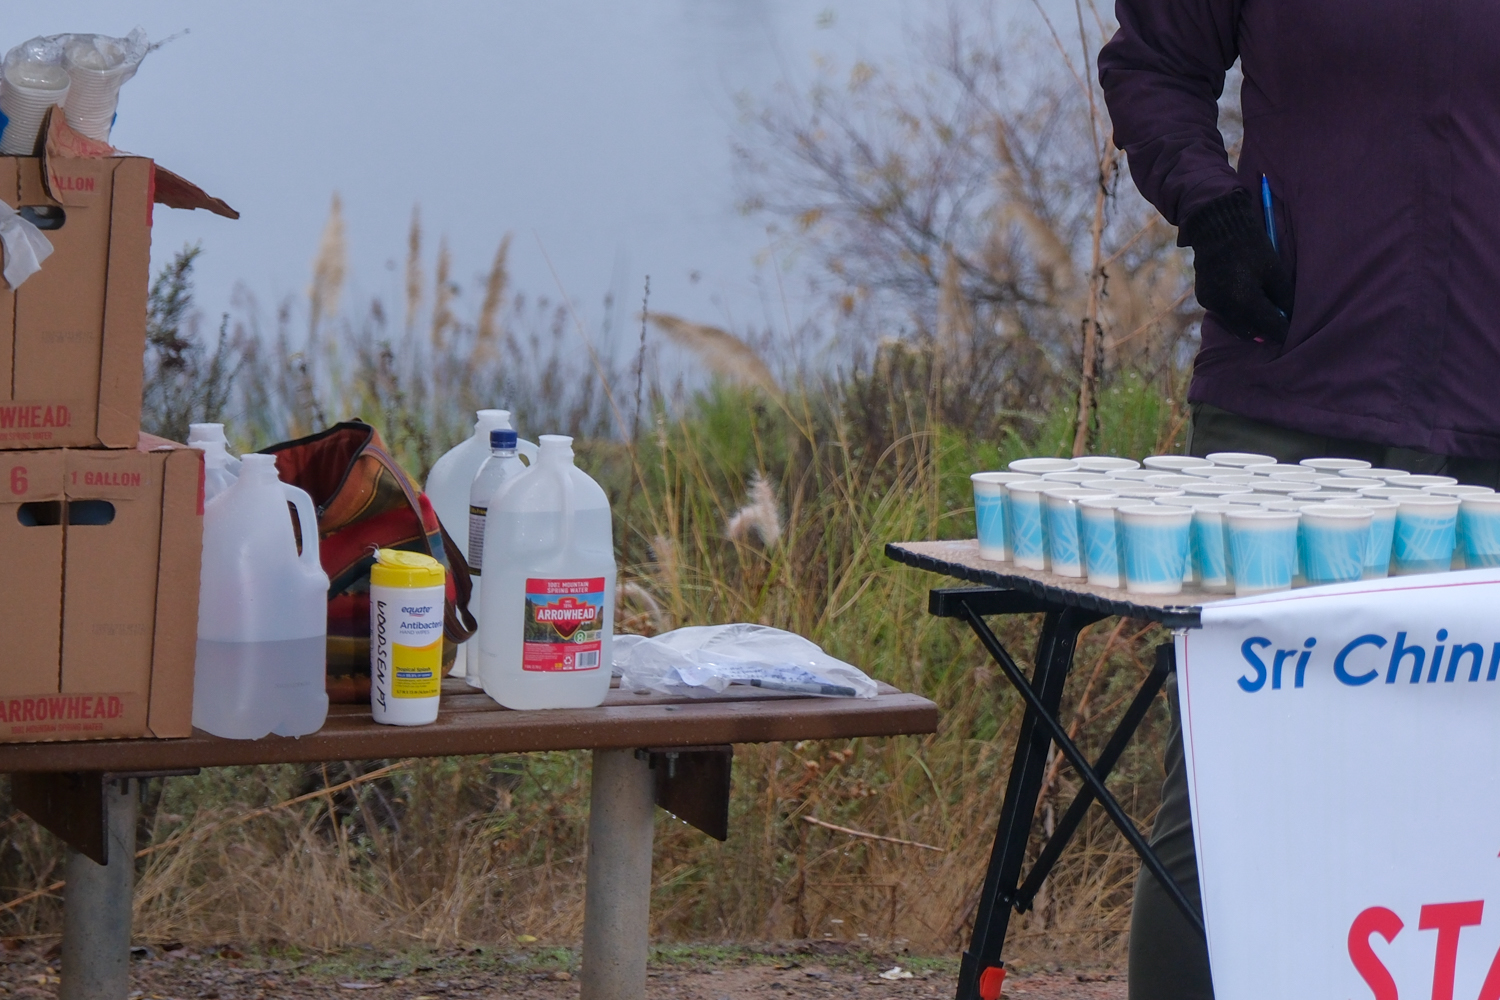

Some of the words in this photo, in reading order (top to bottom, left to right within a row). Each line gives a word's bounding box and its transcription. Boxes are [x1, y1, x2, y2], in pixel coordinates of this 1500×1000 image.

[10, 466, 28, 495] 6
[71, 471, 79, 486] 1
[84, 471, 141, 487] GALLON
[401, 606, 431, 615] equate
[537, 608, 594, 620] ARROWHEAD
[1238, 637, 1316, 692] Sri
